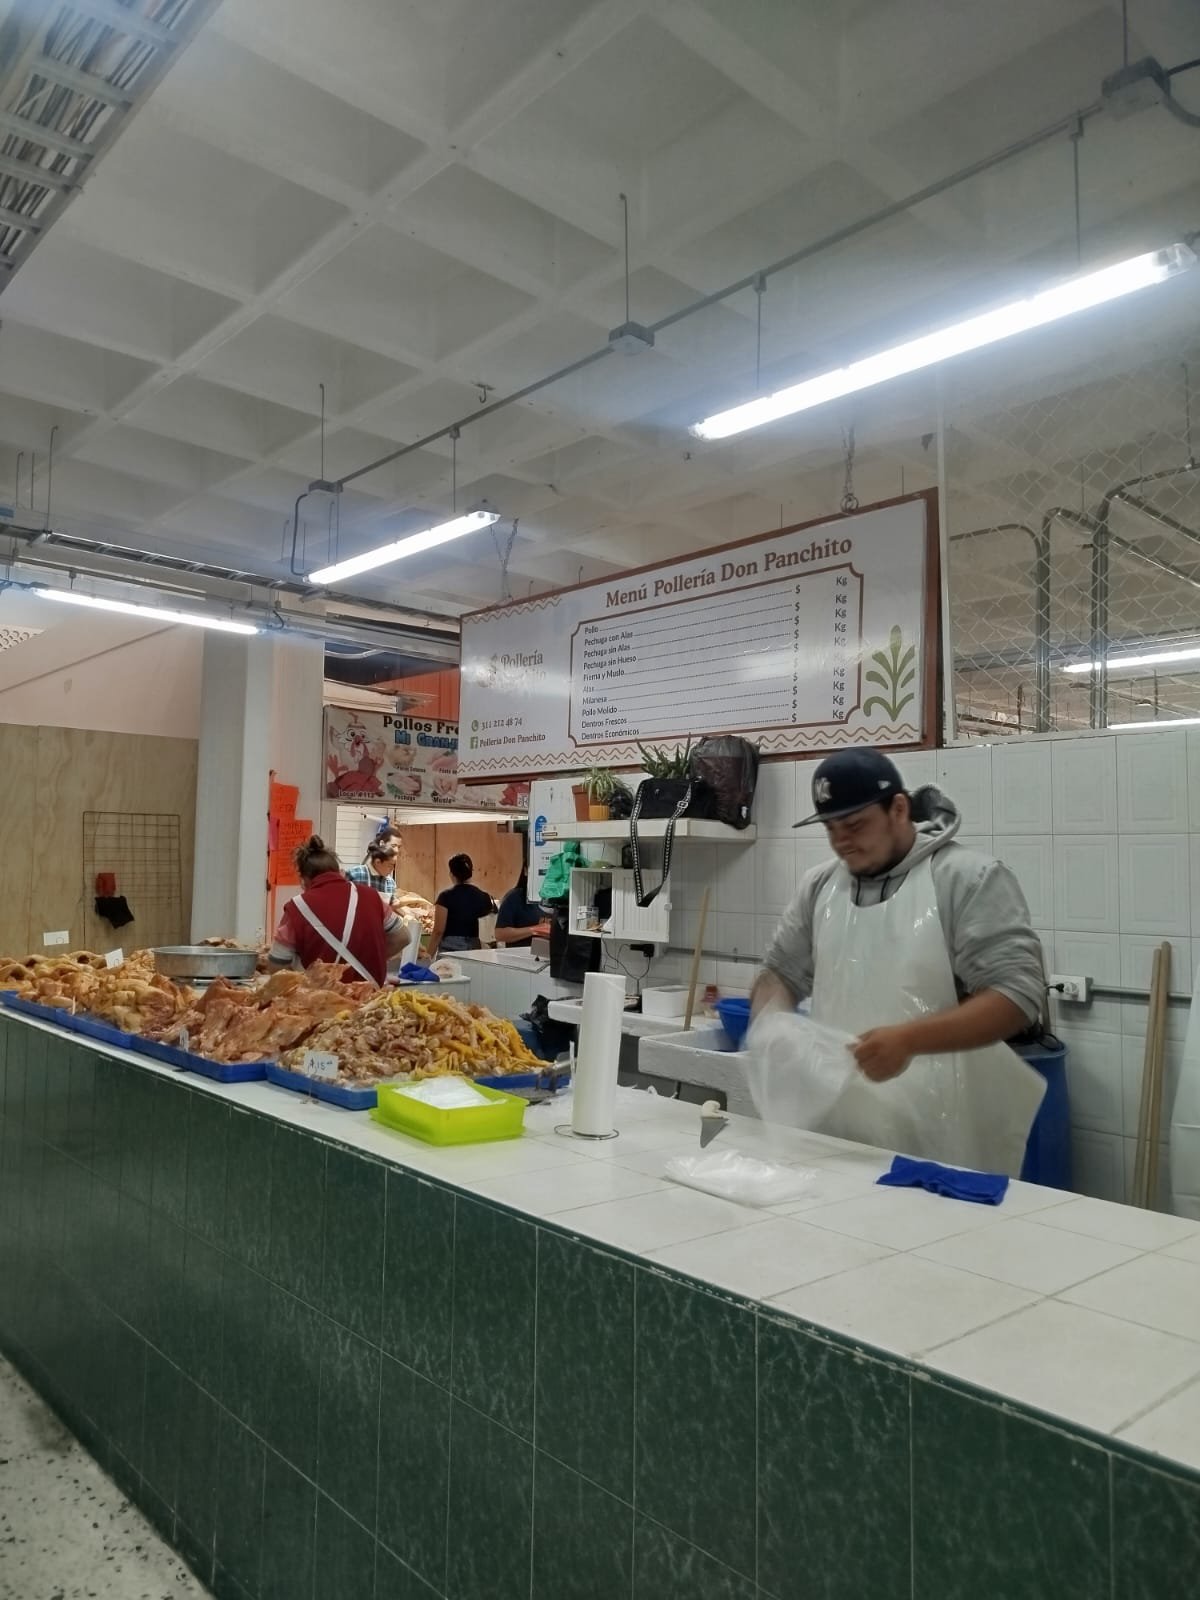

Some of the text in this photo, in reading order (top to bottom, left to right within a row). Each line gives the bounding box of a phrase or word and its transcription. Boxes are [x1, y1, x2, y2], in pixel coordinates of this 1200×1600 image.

[605, 538, 852, 608] Menú Pollería Don Panchito
[584, 576, 848, 635] Pollo $ Kg
[584, 594, 847, 646] Pechuga con Alas $ Kg
[583, 622, 846, 670] Pechuga sin Hueso $ Kg
[584, 648, 607, 658] Pechuga
[617, 643, 631, 652] Alas
[794, 615, 800, 626] $
[835, 608, 846, 618] Kg
[500, 649, 543, 669] Pollería
[606, 668, 625, 678] Muslo
[582, 696, 608, 705] Milanesa
[833, 667, 845, 678] Kg
[582, 681, 844, 717] Pollo Molido $ Kg
[383, 715, 433, 732] Pollos
[604, 727, 640, 738] Económicos
[791, 712, 797, 723] $
[832, 709, 844, 720] Kg
[605, 716, 627, 726] Frescos
[792, 699, 797, 709] $
[832, 695, 844, 706] Kg
[503, 735, 516, 745] Don
[517, 732, 546, 744] Panchito
